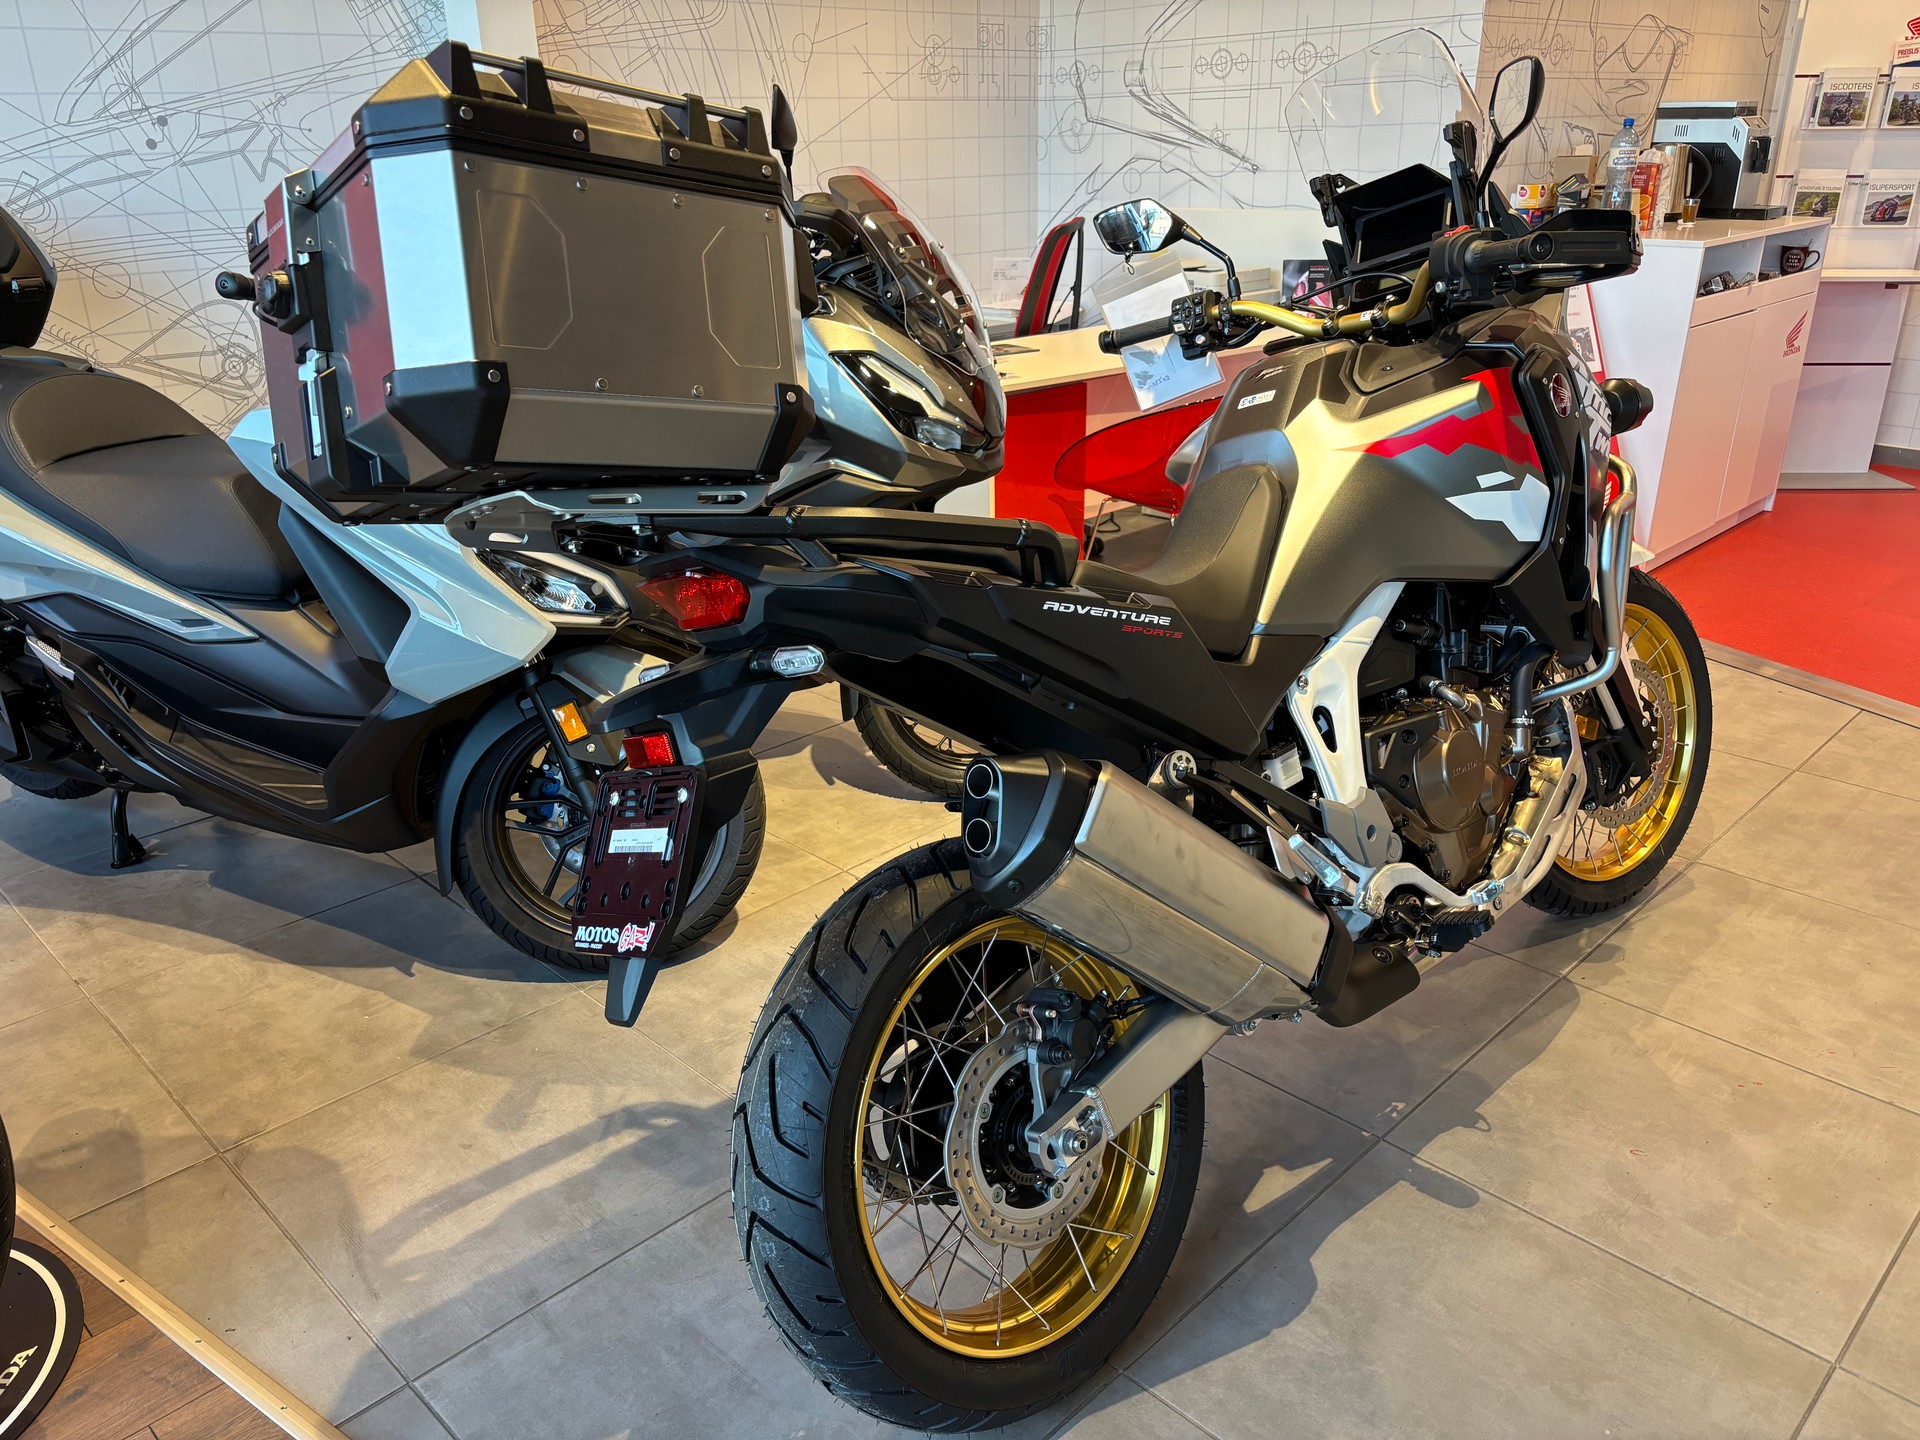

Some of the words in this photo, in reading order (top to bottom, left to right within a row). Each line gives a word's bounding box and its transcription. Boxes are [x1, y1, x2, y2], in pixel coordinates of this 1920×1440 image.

[1783, 345, 1800, 358] HONDA
[1042, 601, 1172, 626] ADVENTURE
[1121, 624, 1184, 639] SPORTS
[574, 925, 620, 944] MOTOS
